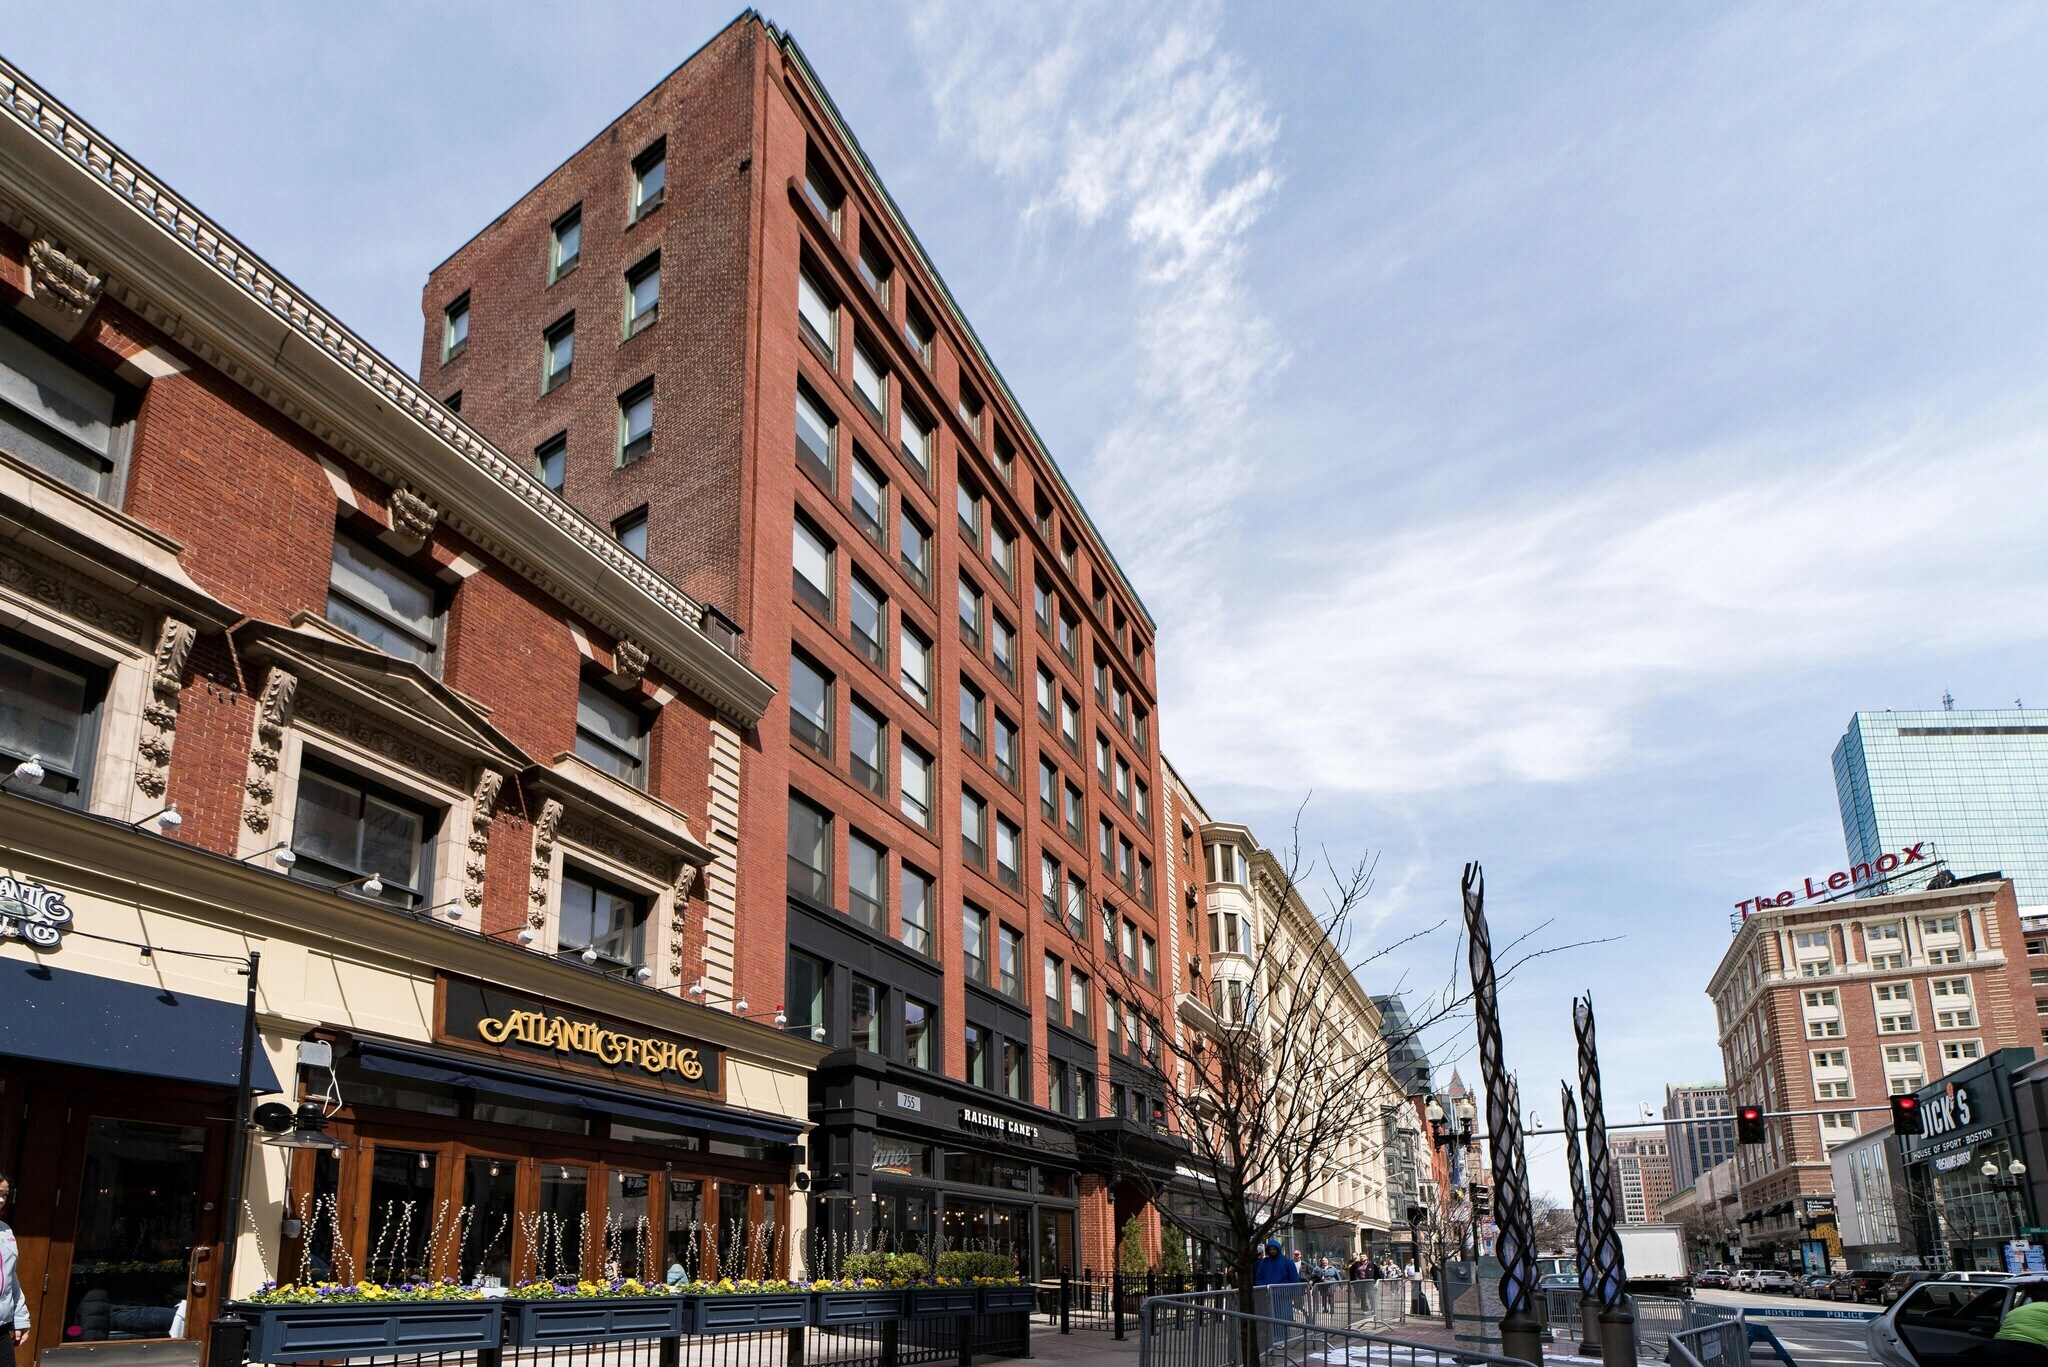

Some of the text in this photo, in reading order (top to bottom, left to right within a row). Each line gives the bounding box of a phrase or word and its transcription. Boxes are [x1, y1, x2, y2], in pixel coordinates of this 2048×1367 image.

[1734, 841, 1925, 921] The Lenox
[477, 1009, 623, 1064] ATLANTIC
[613, 1034, 678, 1073] FISH
[903, 1094, 915, 1109] 755
[964, 1108, 1039, 1138] RAISING CANE'S
[872, 1140, 912, 1168] ane's
[1913, 1128, 1993, 1160] HOUSE OF SPORT BOSTON
[1764, 1309, 1865, 1319] BOSTON POLICE
